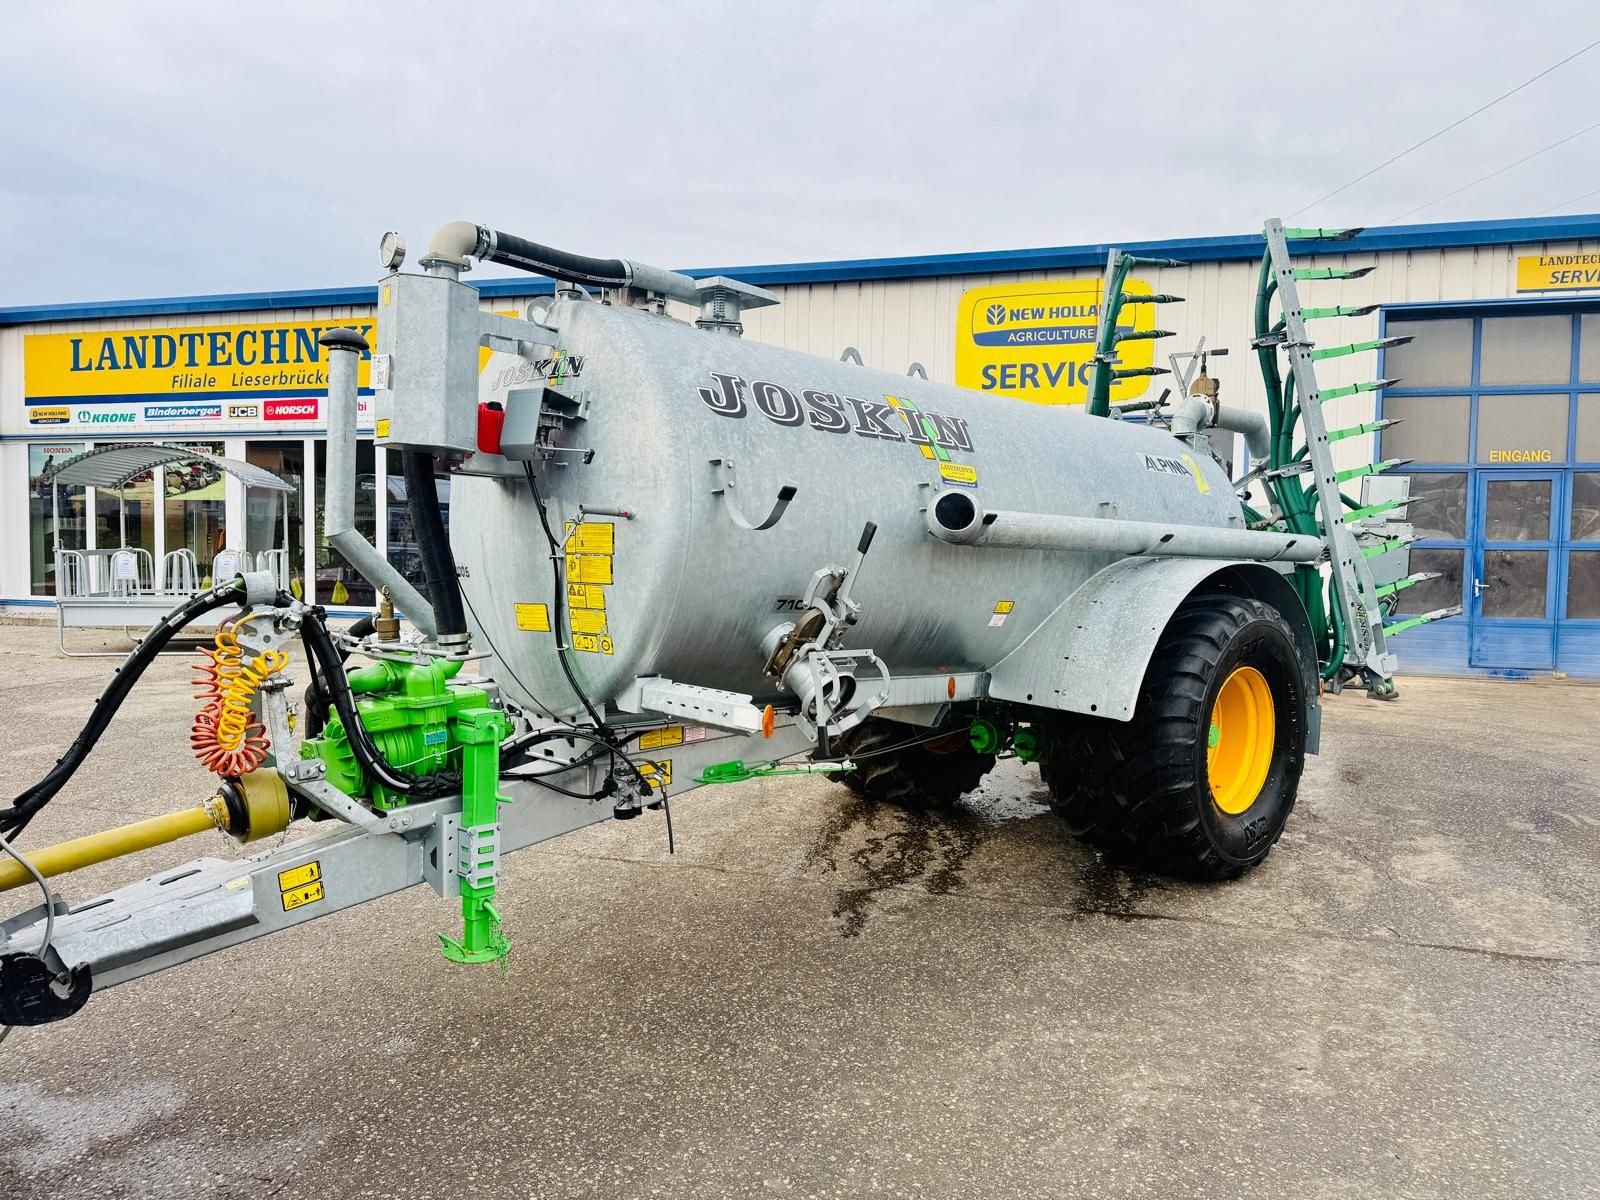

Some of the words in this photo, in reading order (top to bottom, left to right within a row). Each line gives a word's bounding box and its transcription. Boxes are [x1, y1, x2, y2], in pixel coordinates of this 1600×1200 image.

[1009, 307, 1045, 321] NEW
[1049, 303, 1121, 319] HOLLA
[1007, 328, 1095, 343] AGRICULTURE
[70, 326, 372, 371] LANDTECHNK
[172, 373, 217, 389] Filiale
[491, 355, 588, 391] JOSKIN
[981, 360, 1123, 390] SERVIC
[92, 413, 136, 423] KRONE
[146, 407, 220, 417] Binderberger
[230, 407, 257, 417] JCB
[275, 405, 315, 415] HORSCH
[696, 371, 974, 452] JOSKIN
[1489, 449, 1552, 463] EINGANG
[1145, 455, 1192, 477] ALPINA
